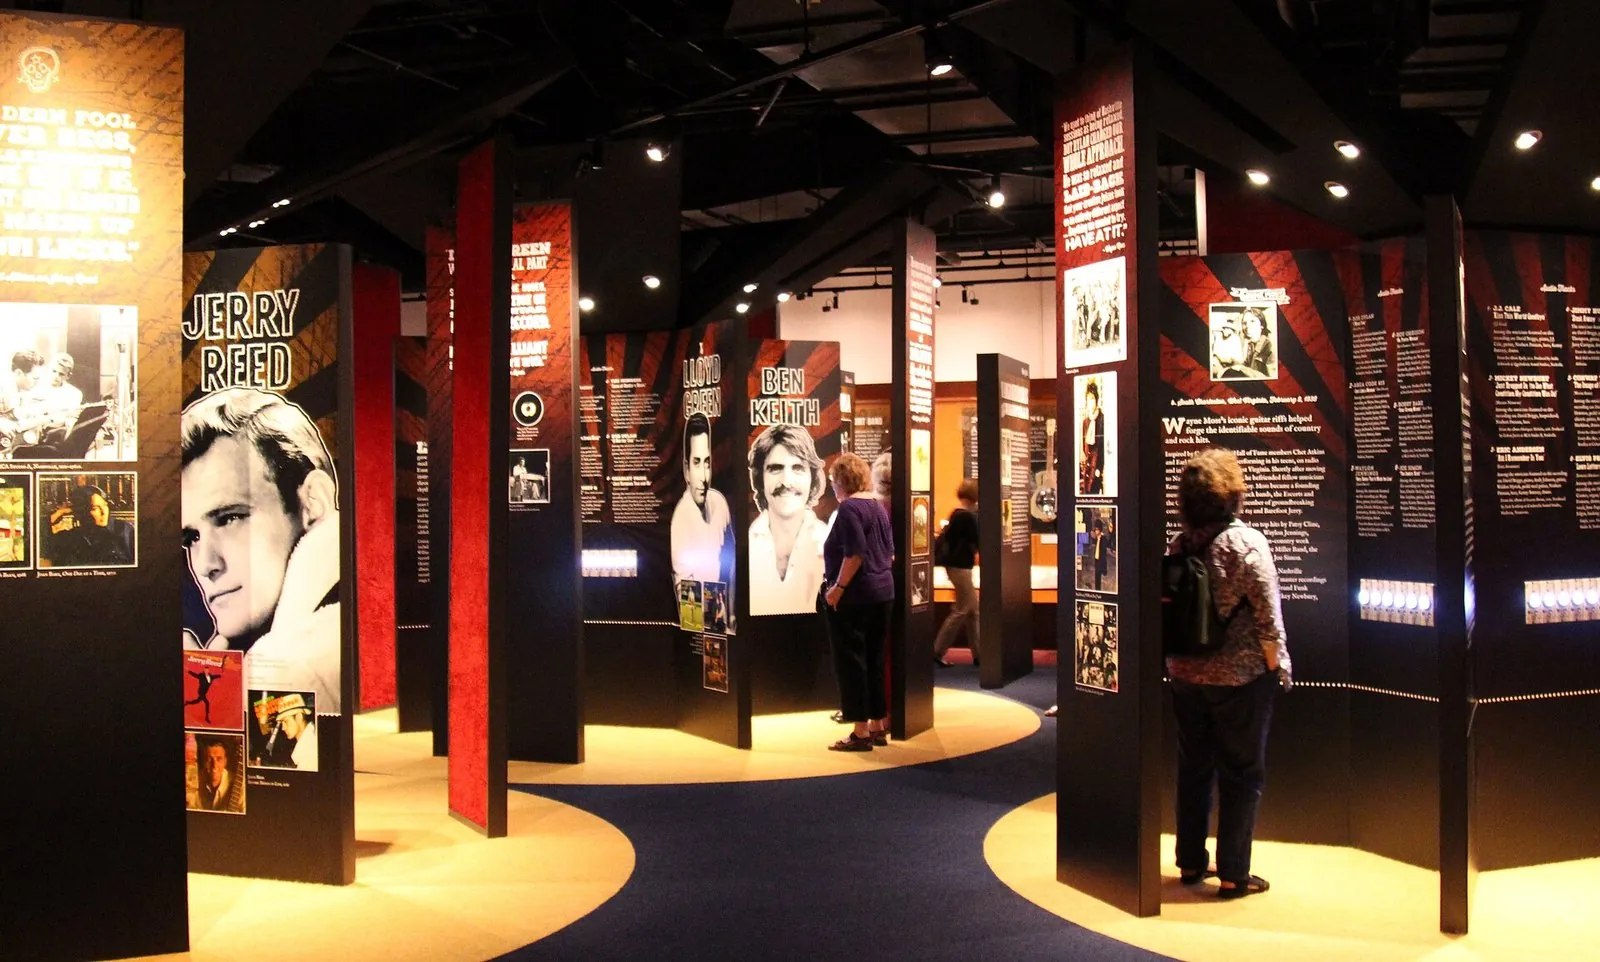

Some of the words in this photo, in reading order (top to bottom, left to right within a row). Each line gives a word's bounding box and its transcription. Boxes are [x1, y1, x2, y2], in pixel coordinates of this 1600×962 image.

[75, 110, 136, 129] FOOL
[511, 241, 551, 257] REEN
[1065, 231, 1096, 252] HAVE
[1095, 226, 1112, 242] AT
[181, 288, 300, 341] JERRY
[201, 341, 292, 392] REED
[683, 354, 721, 389] LLOYD
[762, 367, 805, 395] BEN
[683, 387, 722, 420] GREEN
[750, 398, 820, 426] KEITH
[1186, 427, 1204, 436] forge
[1206, 426, 1217, 434] the
[1218, 425, 1258, 434] identifiable
[1259, 425, 1283, 433] sounds
[1284, 424, 1294, 432] of
[1293, 424, 1322, 434] country
[1227, 416, 1249, 424] iconic
[1249, 416, 1271, 426] guitar
[1271, 415, 1287, 423] riffs
[1288, 414, 1313, 424] helped
[1165, 436, 1178, 444] and
[1178, 436, 1195, 444] rock
[1195, 436, 1211, 444] hits.
[1238, 457, 1265, 465] erforming
